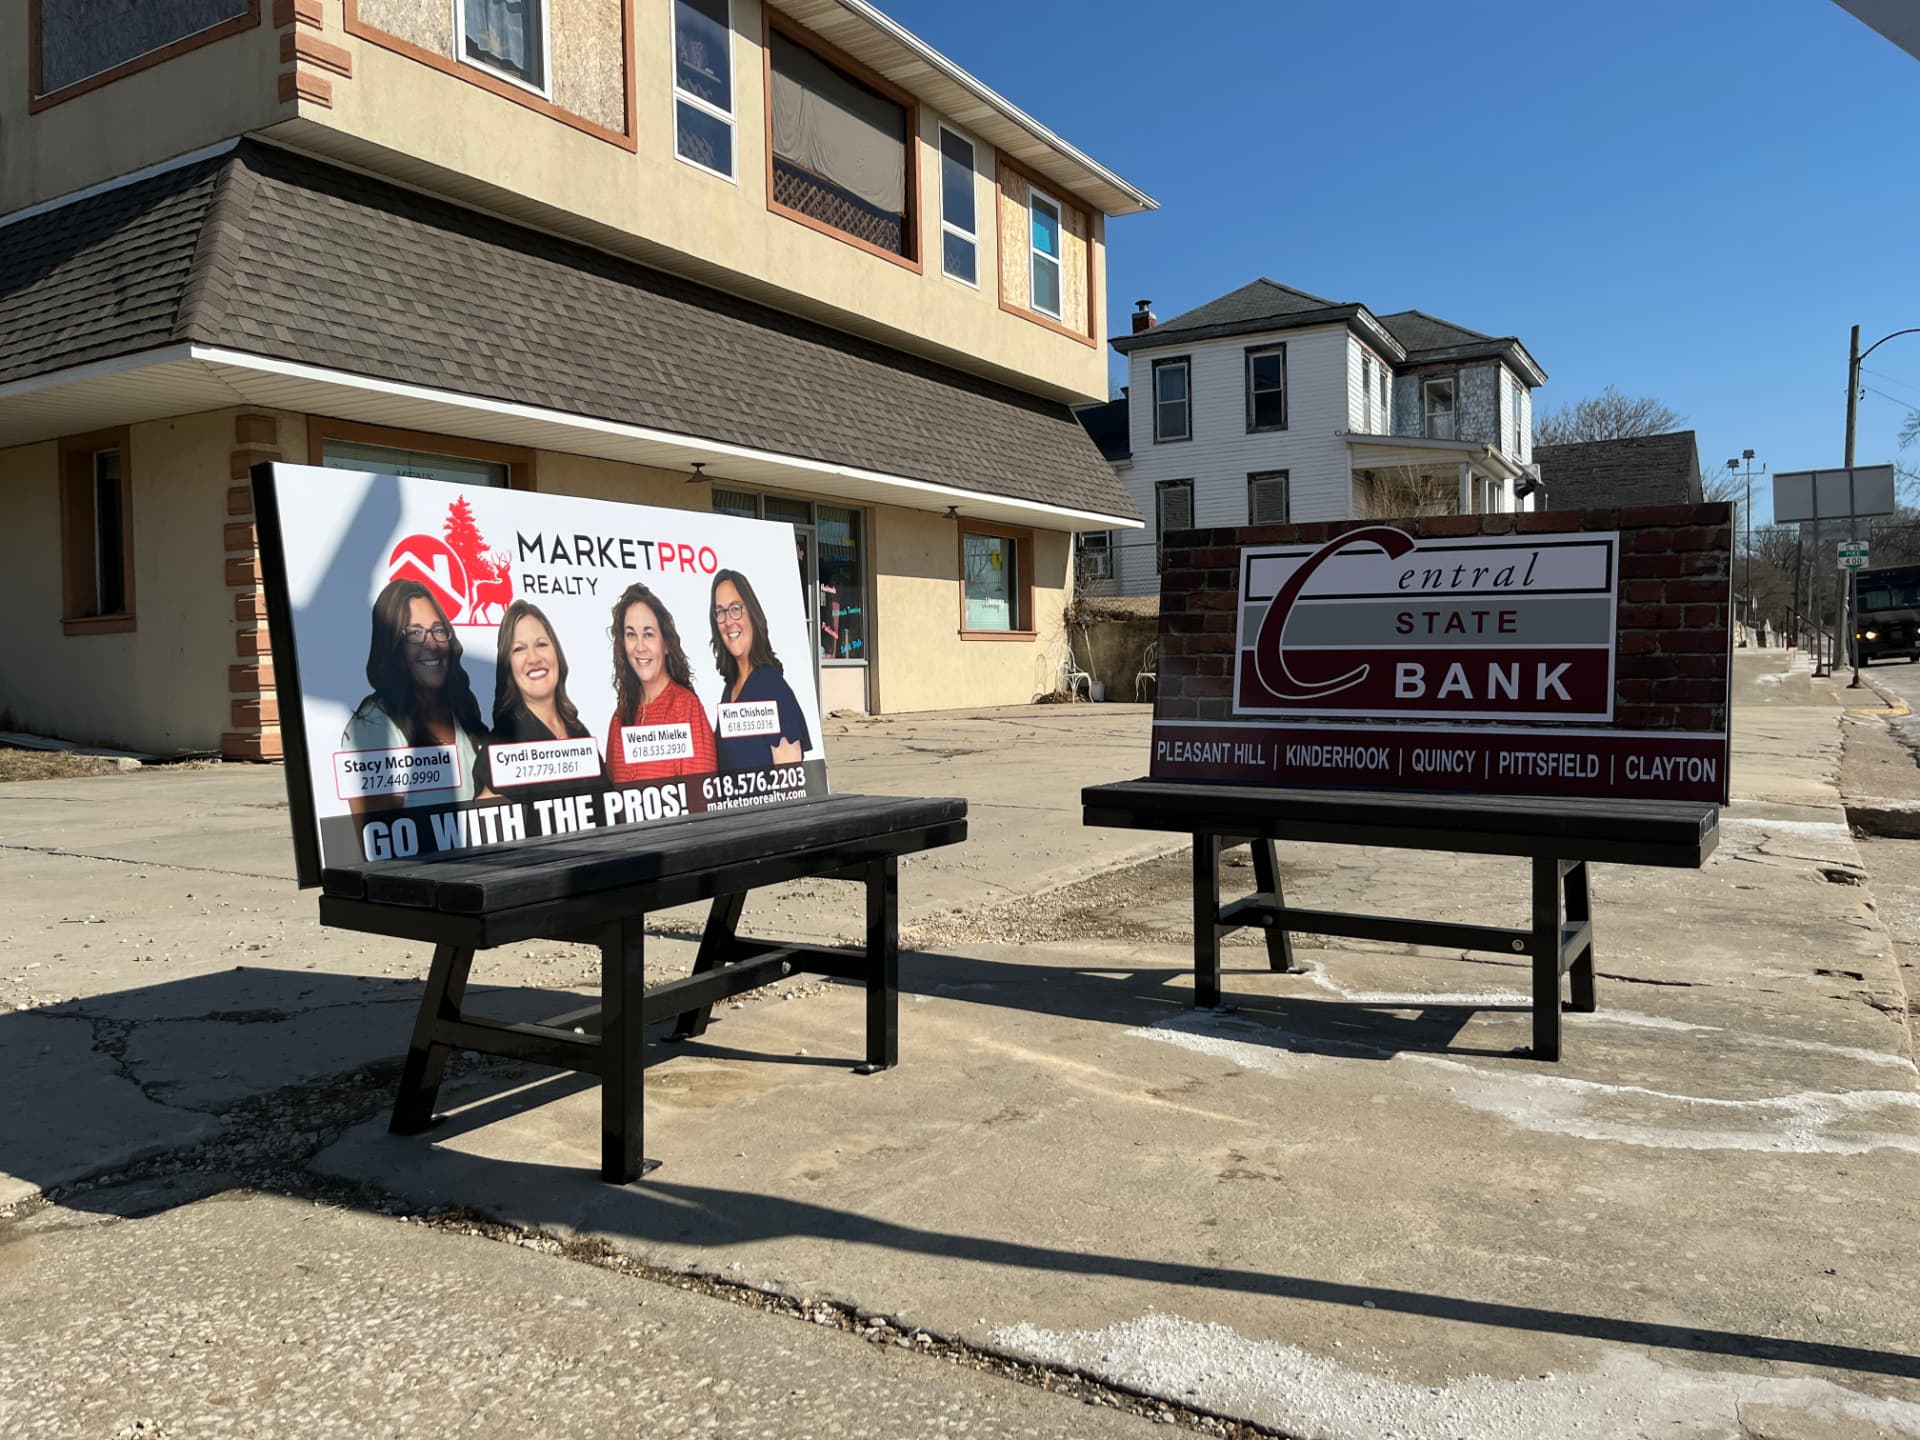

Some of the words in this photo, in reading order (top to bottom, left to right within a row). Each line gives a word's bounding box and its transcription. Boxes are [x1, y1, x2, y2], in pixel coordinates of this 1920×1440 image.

[516, 530, 718, 574] MARKETPRO
[522, 573, 598, 595] REALTY
[1255, 525, 1539, 699] Central
[1395, 610, 1517, 634] STATE
[1394, 662, 1573, 701] BANK
[722, 708, 739, 719] Kim
[739, 705, 775, 718] Chisholm
[627, 731, 657, 744] Wendi
[658, 729, 688, 741] Mielke
[727, 719, 773, 733] 618.535.0316
[496, 749, 529, 765] Cyndi
[531, 745, 593, 761] Borrowman
[632, 743, 686, 758] 618.535.2930
[1157, 740, 1230, 764] PLEASANT
[1234, 743, 1266, 766] HILL
[1286, 744, 1390, 770] KINDERHOOK
[1412, 748, 1476, 774] QUINCY
[1499, 751, 1599, 778] PITTSFIELD
[1626, 755, 1716, 783] CLAYTON
[344, 758, 381, 774] Stacy
[385, 752, 450, 769] McDonald
[515, 761, 579, 778] 217.779.1861
[361, 770, 441, 790] 217.440.9990
[702, 766, 806, 799] 618.576.2203
[706, 788, 806, 812] marketprorealty.com
[362, 817, 418, 862] GO
[429, 803, 526, 850] WITH
[534, 794, 596, 837] THE
[604, 782, 690, 827] PROS!
